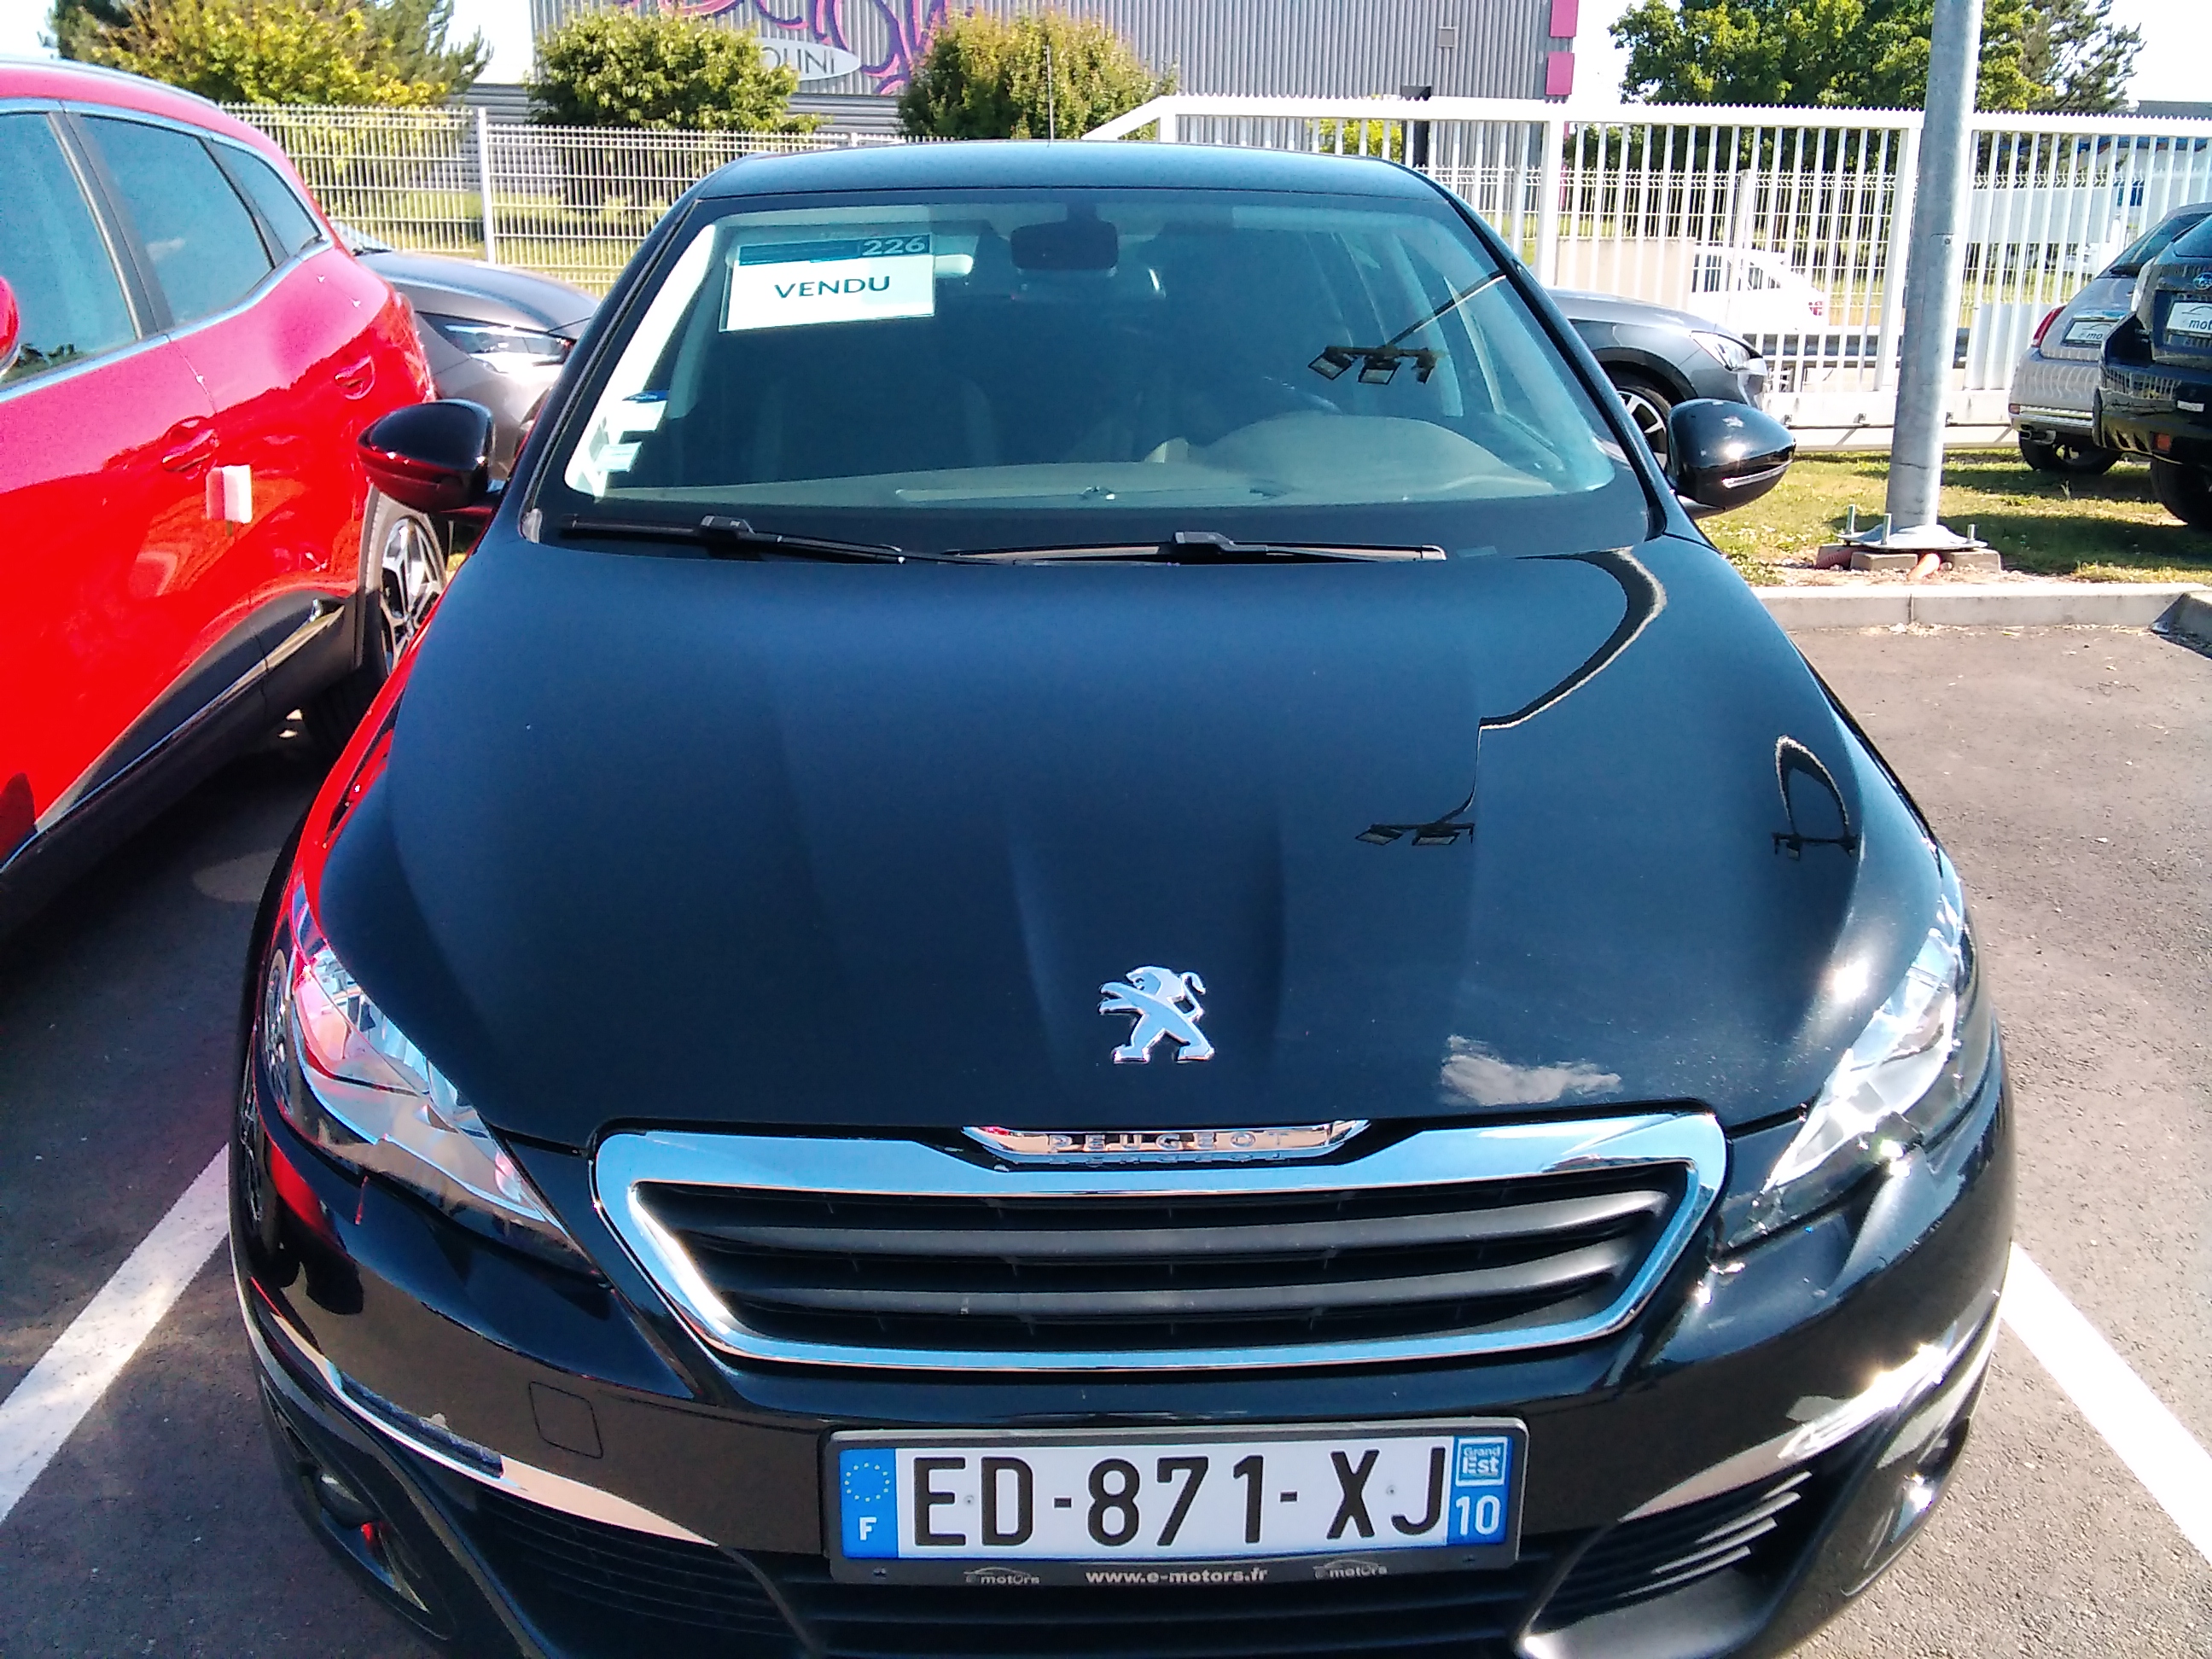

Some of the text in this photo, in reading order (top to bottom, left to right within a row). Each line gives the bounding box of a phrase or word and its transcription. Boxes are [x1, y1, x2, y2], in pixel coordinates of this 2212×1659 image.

[761, 46, 835, 74] OLINI
[862, 236, 926, 256] 226
[774, 276, 890, 299] VENDU
[1048, 1131, 1288, 1153] PEUGEOT
[1464, 1446, 1501, 1457] Grand
[1462, 1456, 1499, 1476] Est
[1456, 1494, 1501, 1536] 10
[859, 1516, 877, 1540] F
[1085, 1567, 1268, 1584] www.e-motors.fr
